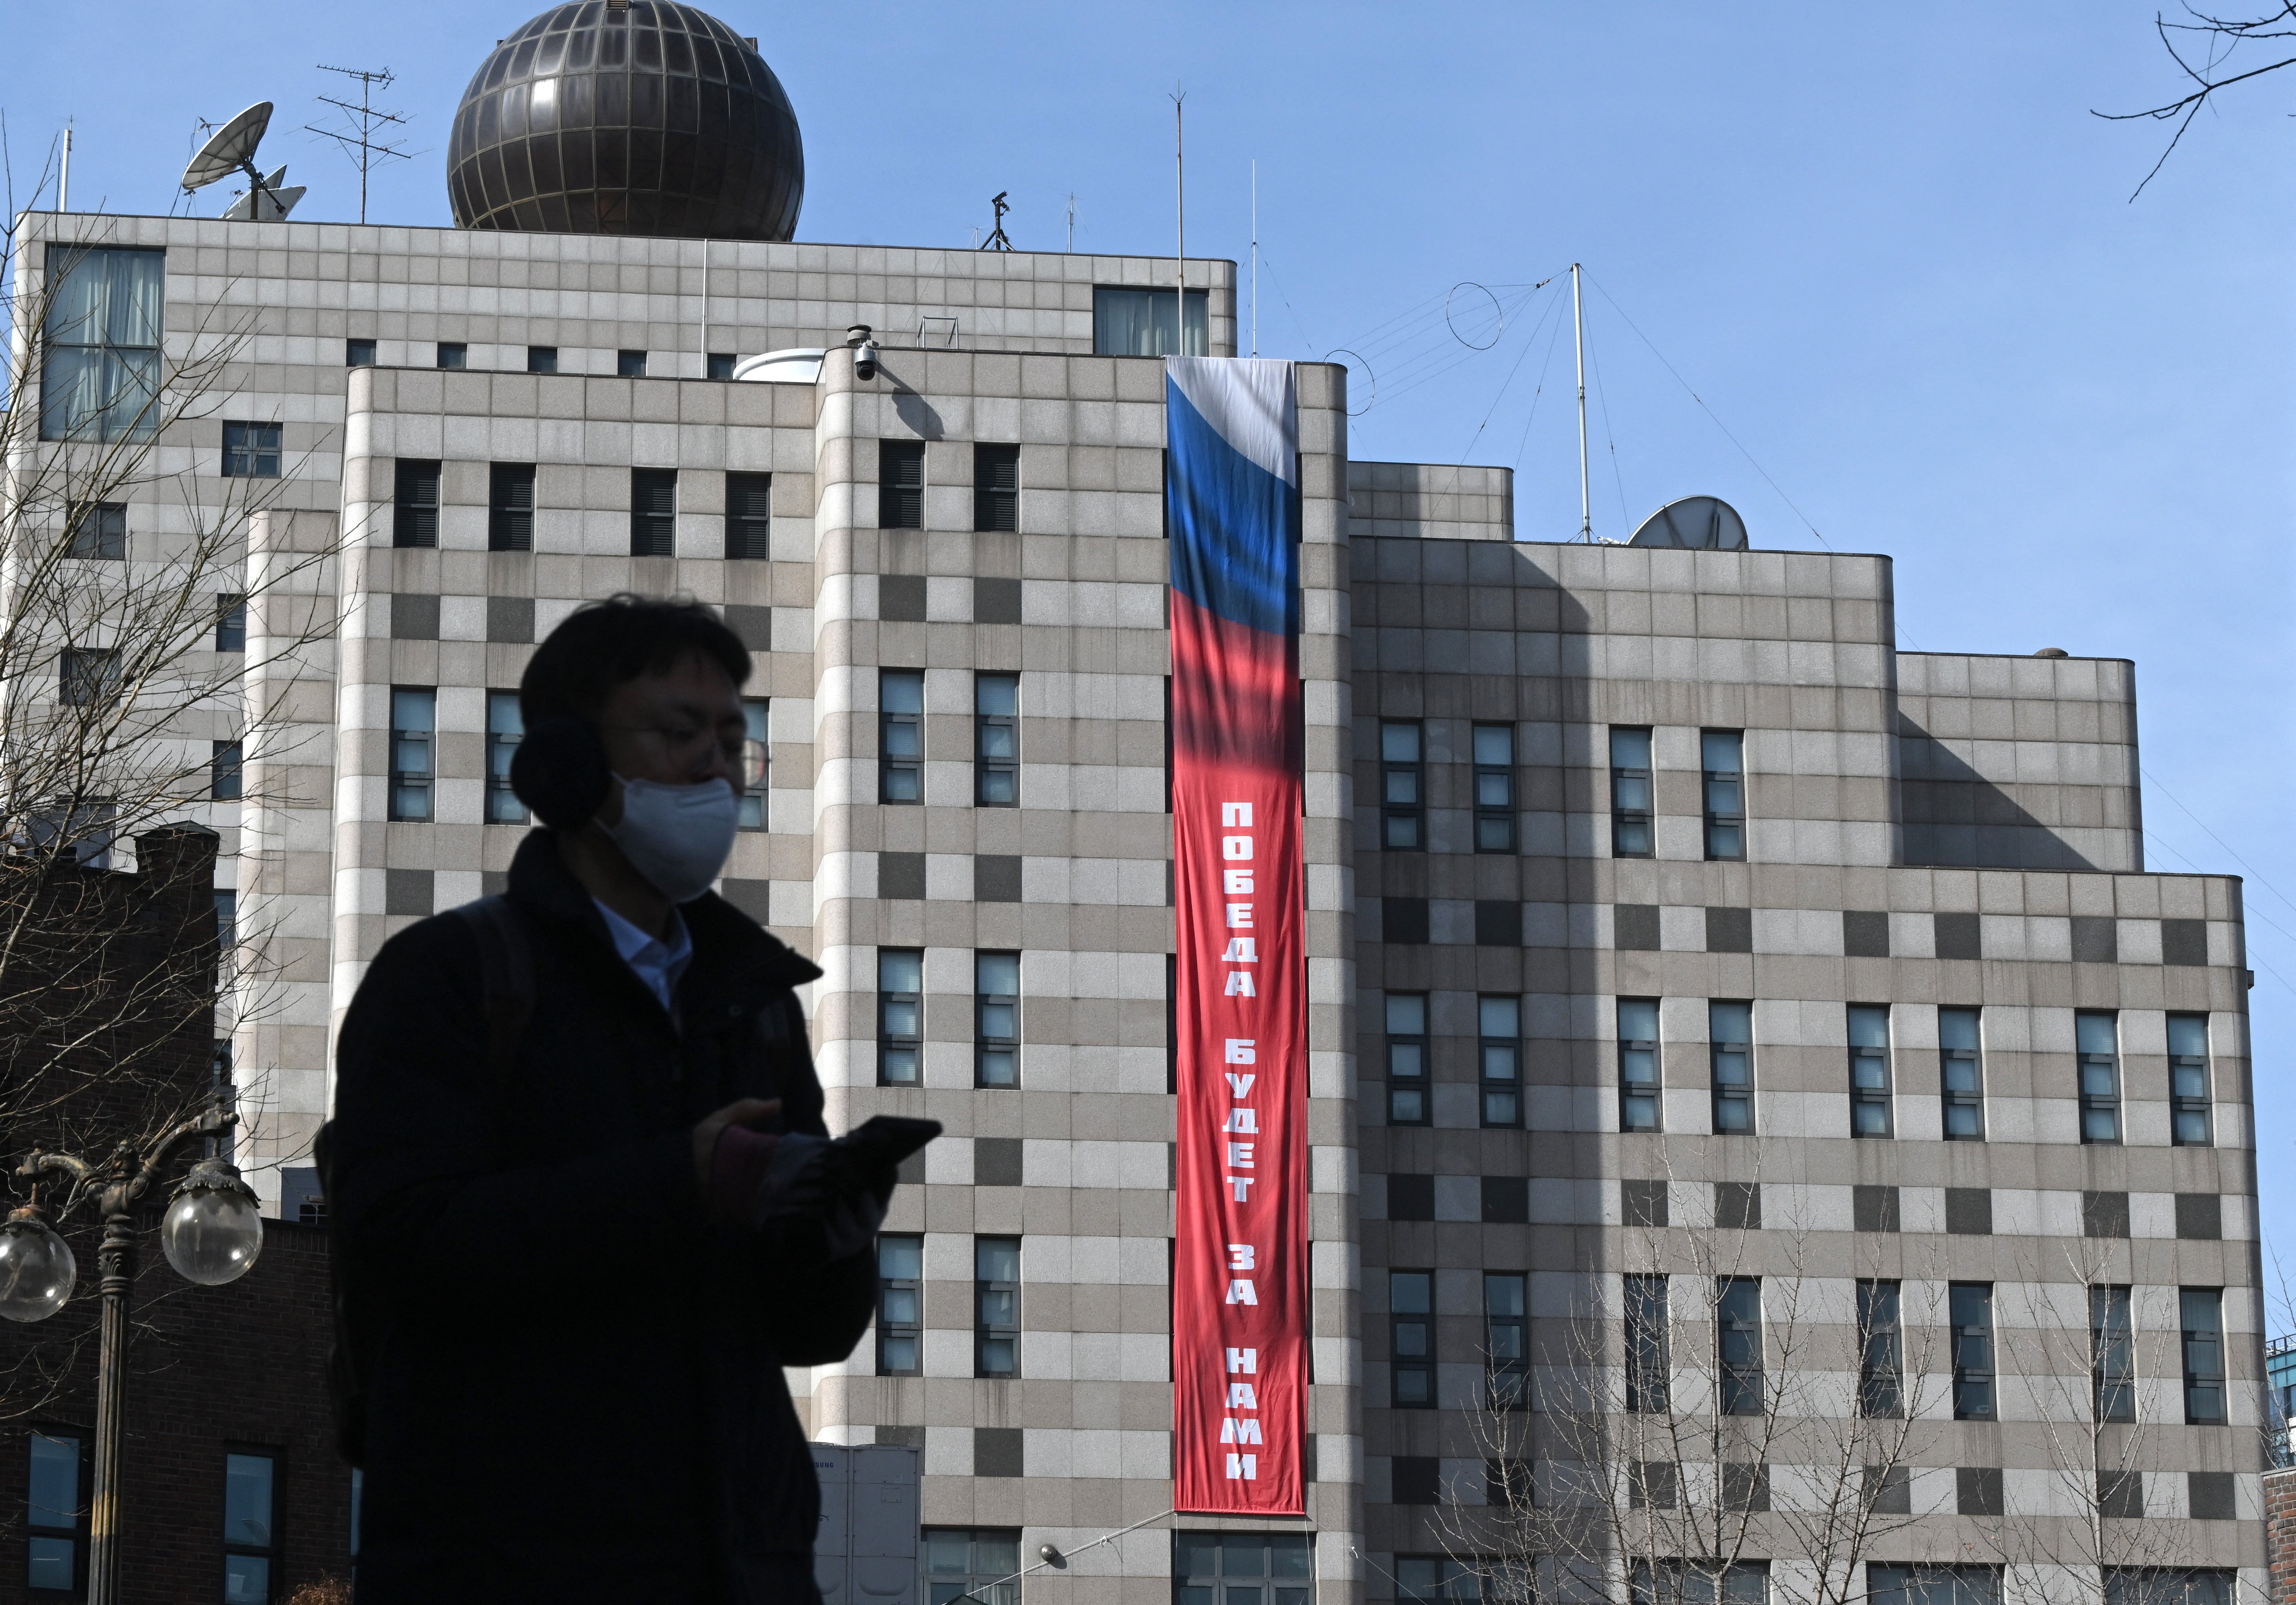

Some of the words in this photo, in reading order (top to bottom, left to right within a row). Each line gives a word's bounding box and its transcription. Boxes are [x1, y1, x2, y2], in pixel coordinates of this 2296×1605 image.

[1222, 802, 1258, 997] ПОБЕДА
[1222, 1038, 1259, 1202] БУДЕТ
[1225, 1244, 1257, 1305] ЗА
[1220, 1347, 1262, 1480] НАМИ
